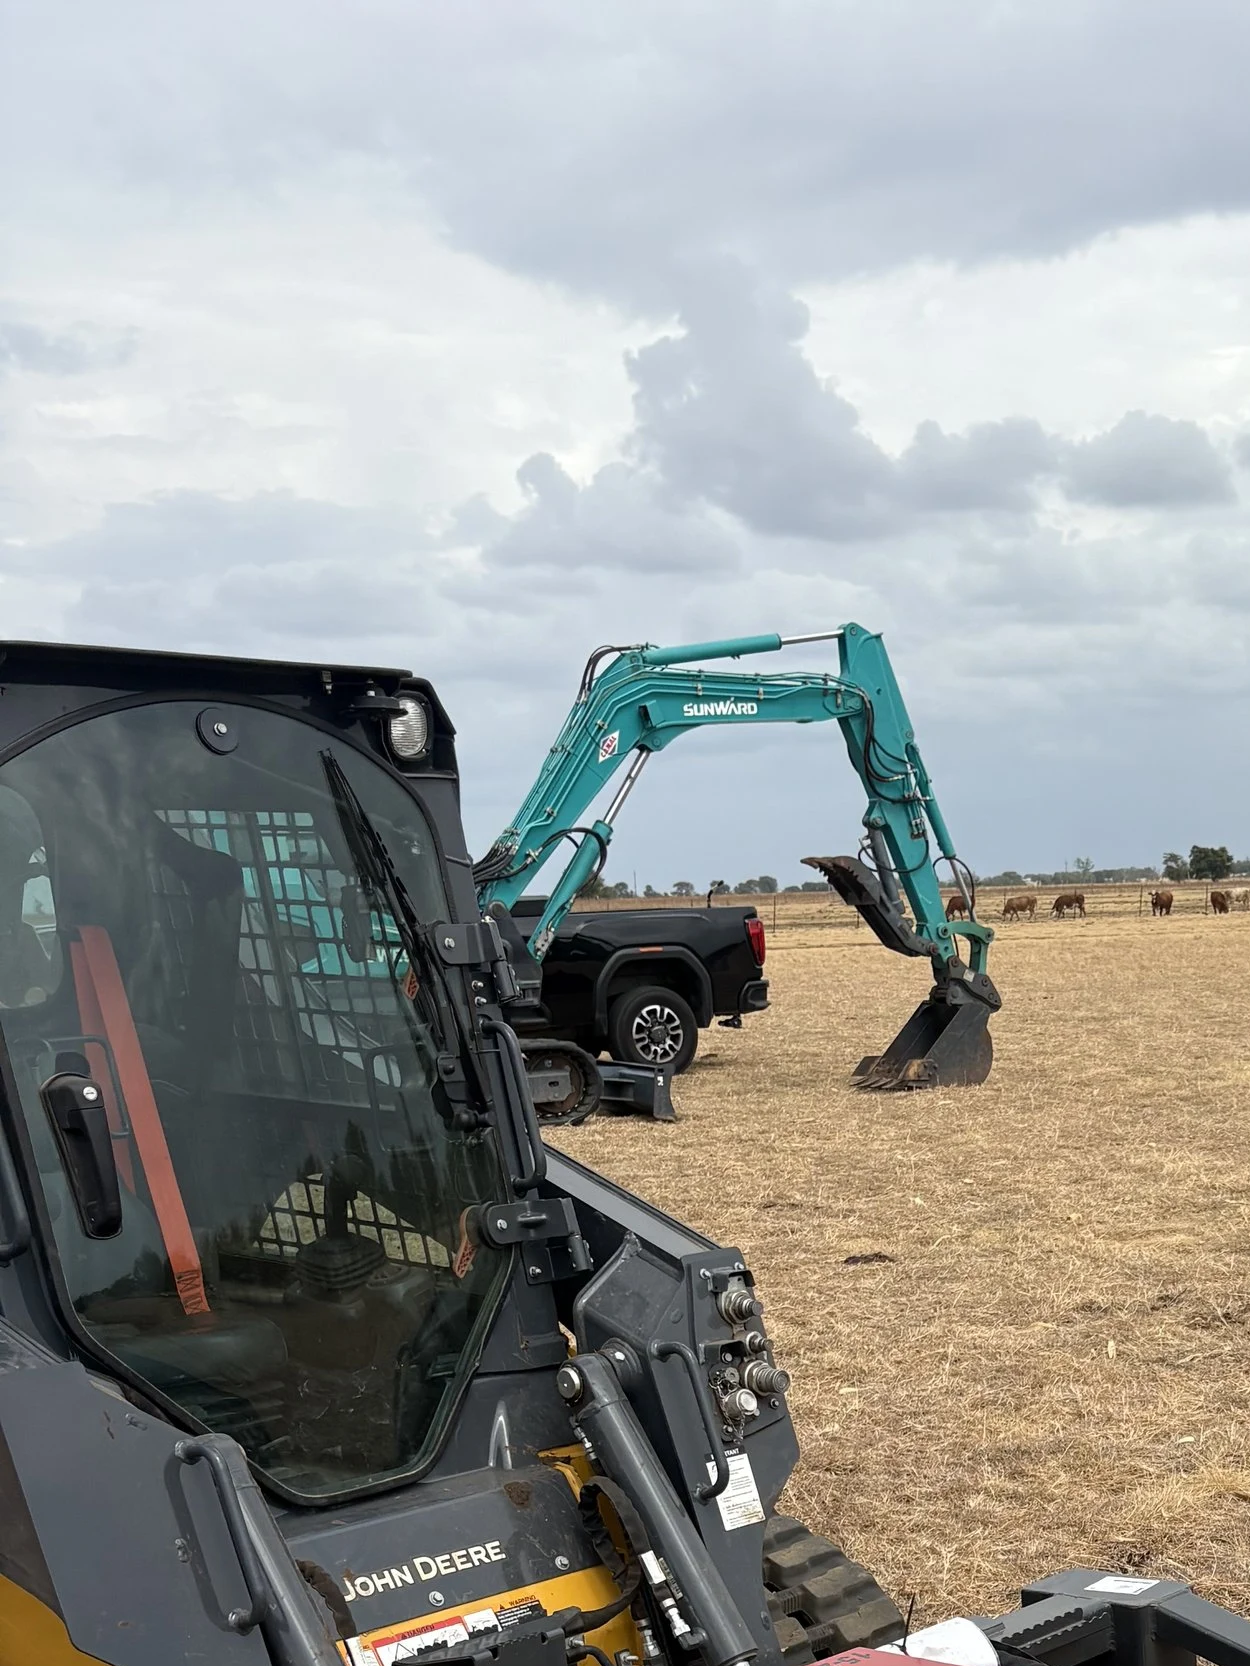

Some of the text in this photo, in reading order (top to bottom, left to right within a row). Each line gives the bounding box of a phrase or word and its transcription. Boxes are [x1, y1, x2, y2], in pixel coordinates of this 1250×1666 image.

[683, 697, 758, 717] SUNWARD
[344, 1540, 507, 1602] JOHN DEERE
